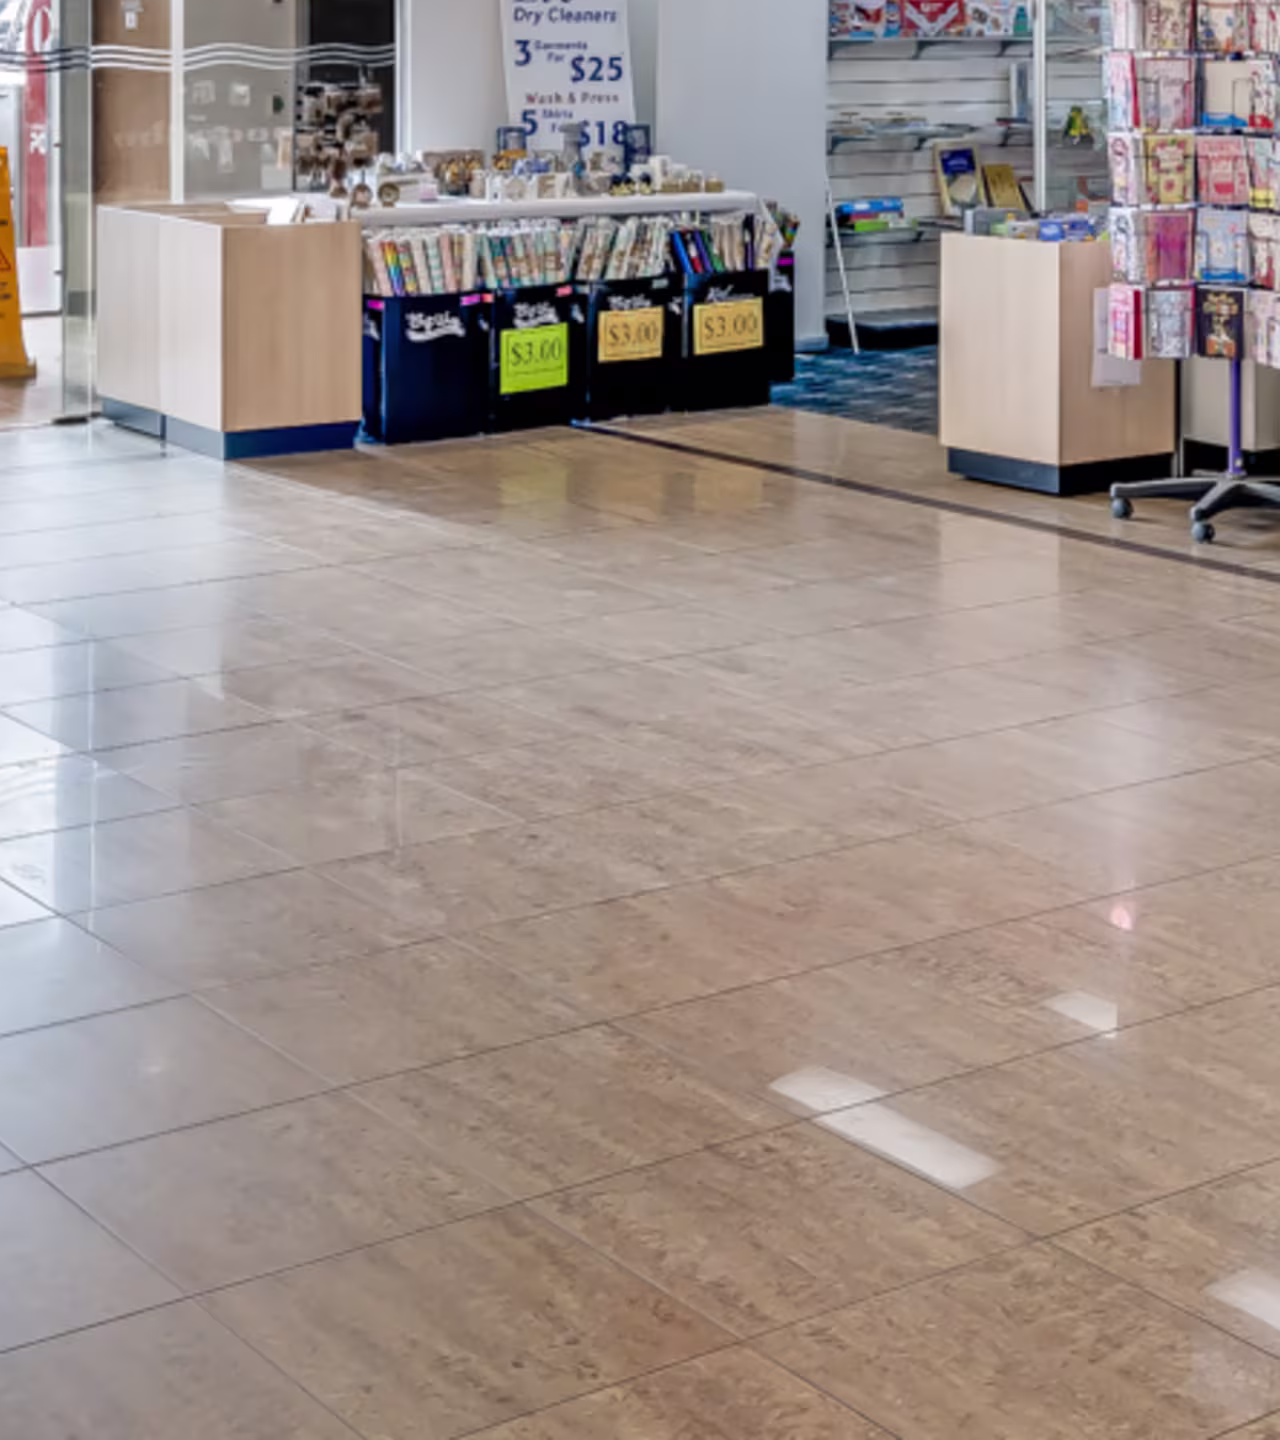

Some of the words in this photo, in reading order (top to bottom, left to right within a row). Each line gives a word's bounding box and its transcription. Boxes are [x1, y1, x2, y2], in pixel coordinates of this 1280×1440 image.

[513, 8, 543, 25] Dry
[548, 7, 617, 23] Cleaners
[514, 39, 532, 67] 3
[534, 40, 587, 50] Garments
[571, 55, 623, 83] $25
[522, 109, 538, 136] 5
[608, 320, 658, 347] $3.00
[704, 312, 757, 340] $3.00
[511, 336, 561, 366] $3.00
